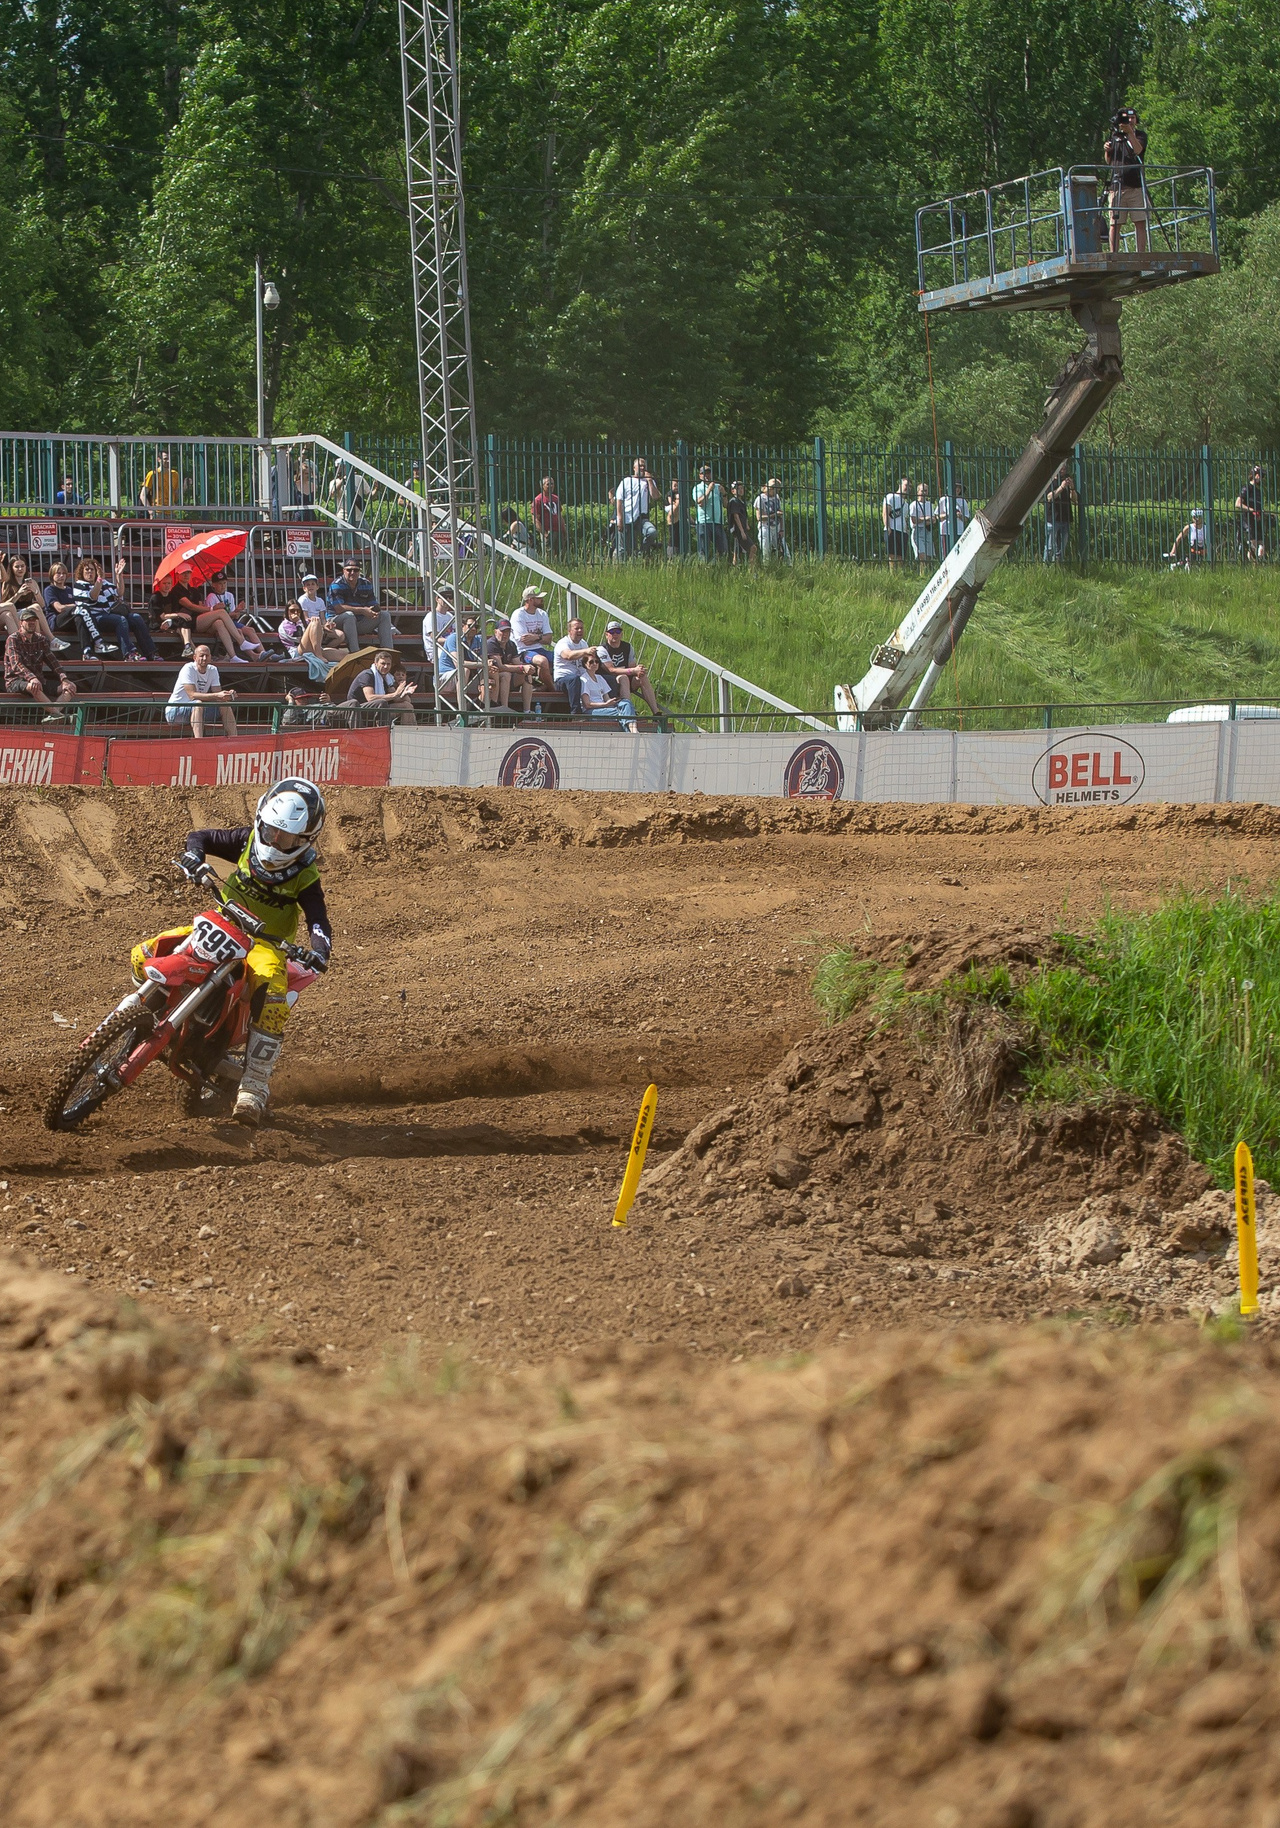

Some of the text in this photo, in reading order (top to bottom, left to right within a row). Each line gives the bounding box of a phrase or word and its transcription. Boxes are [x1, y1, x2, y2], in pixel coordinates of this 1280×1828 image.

[217, 738, 339, 785] МОСКОВСКИЙ
[1049, 752, 1131, 789] BELL
[1056, 790, 1120, 804] HELMETS
[235, 884, 287, 910] DEMIX
[226, 903, 259, 927] SCAR
[197, 921, 241, 962] 695
[251, 1040, 278, 1061] G
[634, 1105, 651, 1156] ACERBIS
